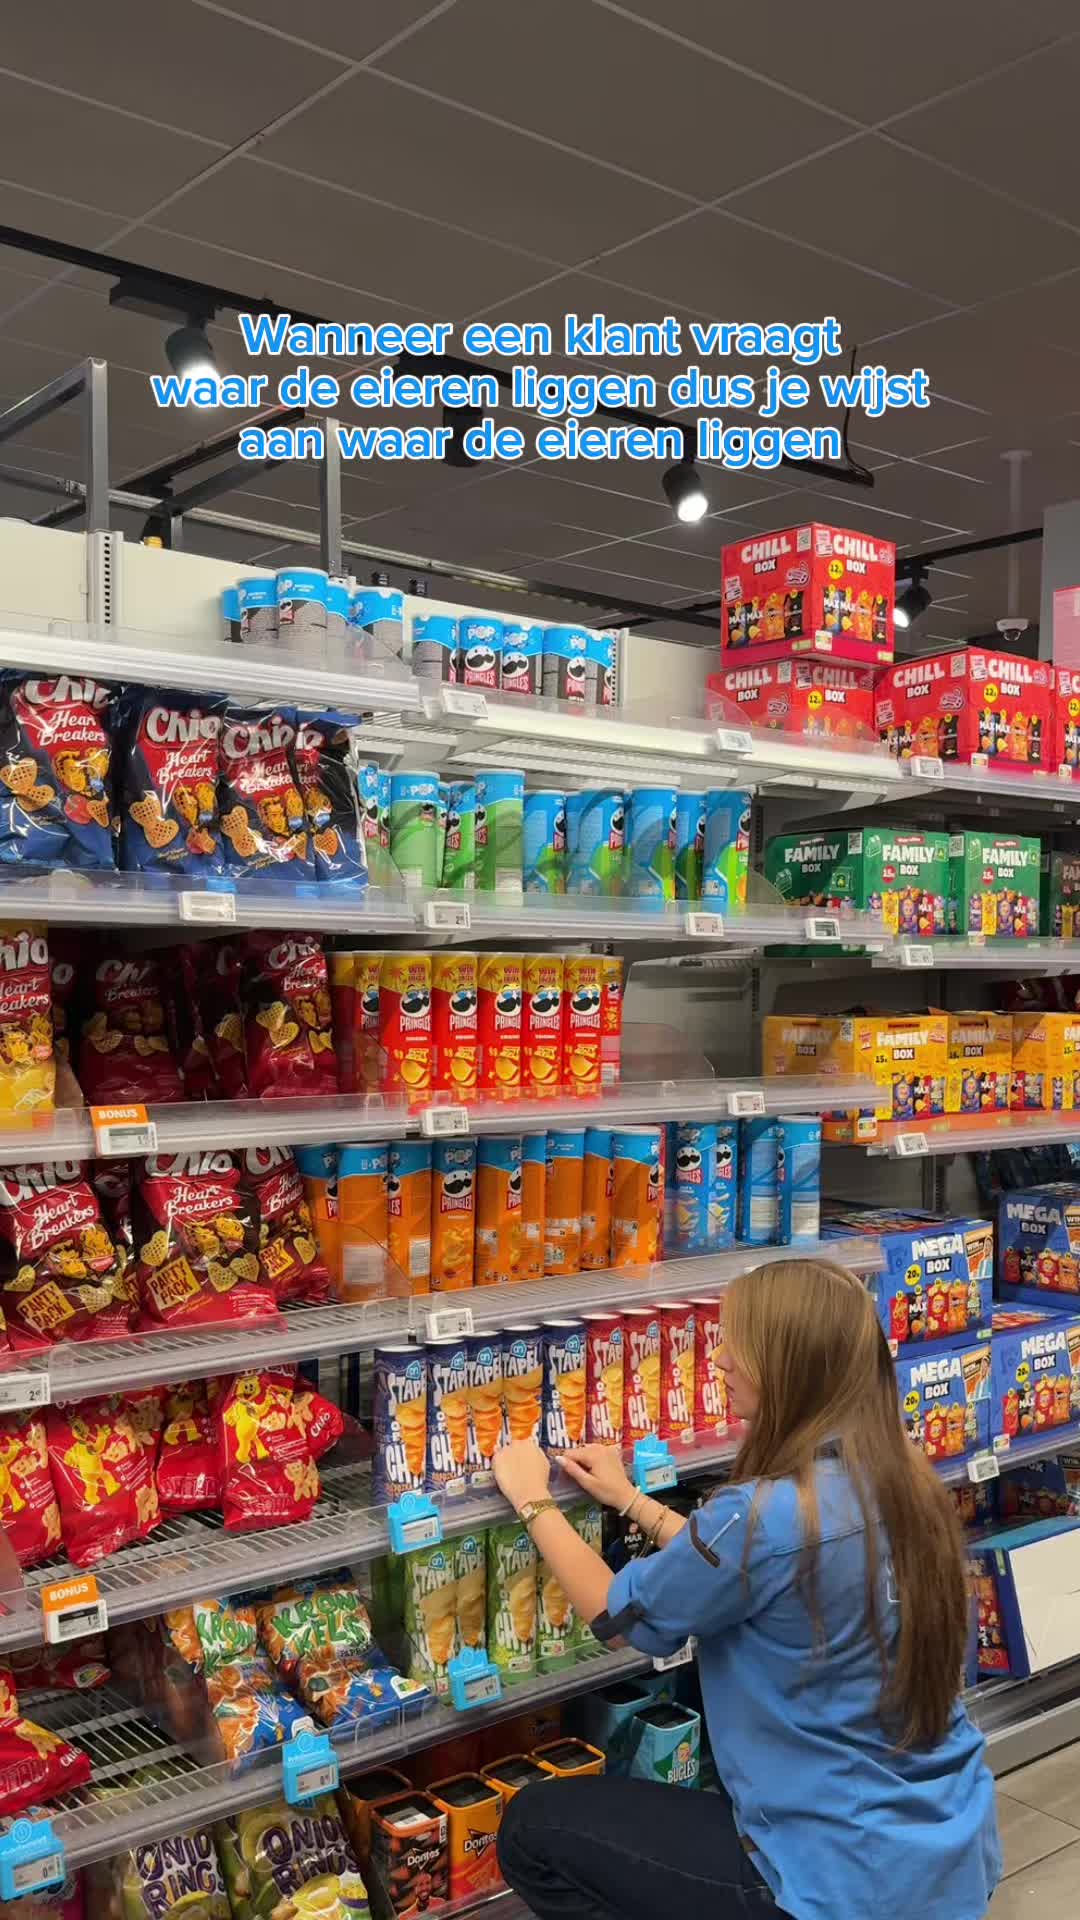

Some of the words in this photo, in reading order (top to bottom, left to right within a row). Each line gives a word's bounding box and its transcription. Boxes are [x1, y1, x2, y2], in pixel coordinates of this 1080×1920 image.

[741, 535, 792, 564] CHILL
[833, 535, 879, 562] CHILL
[754, 559, 776, 573] BOX
[846, 560, 866, 574] BOX
[823, 599, 840, 610] MAX
[840, 601, 857, 612] MAX
[468, 626, 496, 640] POP
[504, 631, 529, 647] POP
[464, 670, 497, 687] PRINGLES
[725, 668, 772, 690] CHILL
[813, 666, 858, 688] CHILL
[893, 662, 945, 688] CHILL
[988, 659, 1033, 683] CHILL
[737, 689, 758, 702] BOX
[824, 689, 846, 703] BOX
[907, 685, 929, 698] BOX
[1001, 682, 1021, 697] BOX
[146, 707, 221, 743] Chio
[37, 729, 106, 747] Breakers
[222, 715, 295, 760] Chio
[166, 750, 212, 769] Heart
[157, 766, 213, 785] Breakers
[784, 843, 840, 863] FAMILY
[882, 844, 935, 863] FAMILY
[982, 847, 1028, 866] FAMILY
[802, 863, 821, 873] BOX
[900, 864, 919, 875] BOX
[997, 867, 1014, 878] BOX
[0, 931, 49, 971] hio
[96, 959, 150, 983] Chi
[0, 994, 49, 1014] eakers
[530, 1014, 560, 1030] PRINGLES
[570, 1013, 600, 1029] PRINGLES
[876, 1031, 929, 1047] FAMILY
[797, 1045, 816, 1055] BOX
[893, 1048, 915, 1060] BOX
[965, 1046, 983, 1057] BOX
[98, 1108, 139, 1120] BONUS
[445, 1150, 473, 1164] POP
[169, 1184, 222, 1204] Heart
[441, 1194, 473, 1213] PRINGLES
[33, 1191, 79, 1223] Heart
[163, 1196, 233, 1217] Breakers
[1006, 1203, 1062, 1226] MEGA
[29, 1205, 95, 1250] Breakers
[1021, 1222, 1046, 1234] BOX
[912, 1234, 963, 1261] MEGA
[926, 1258, 950, 1274] BOX
[150, 1260, 190, 1295] PARTY
[160, 1277, 194, 1305] PACK
[19, 1286, 61, 1316] PARTY
[32, 1303, 67, 1328] PACK
[1021, 1331, 1067, 1359] MEGA
[1034, 1355, 1056, 1370] BOX
[910, 1358, 962, 1388] MEGA
[925, 1382, 949, 1399] BOX
[310, 1412, 331, 1437] Chio
[624, 1534, 643, 1544] MAX
[50, 1583, 89, 1601] BONUS
[667, 1757, 697, 1784] BUGLES
[464, 1832, 497, 1852] Doritos
[136, 1831, 211, 1881] ONIO
[407, 1848, 440, 1866] Doritos
